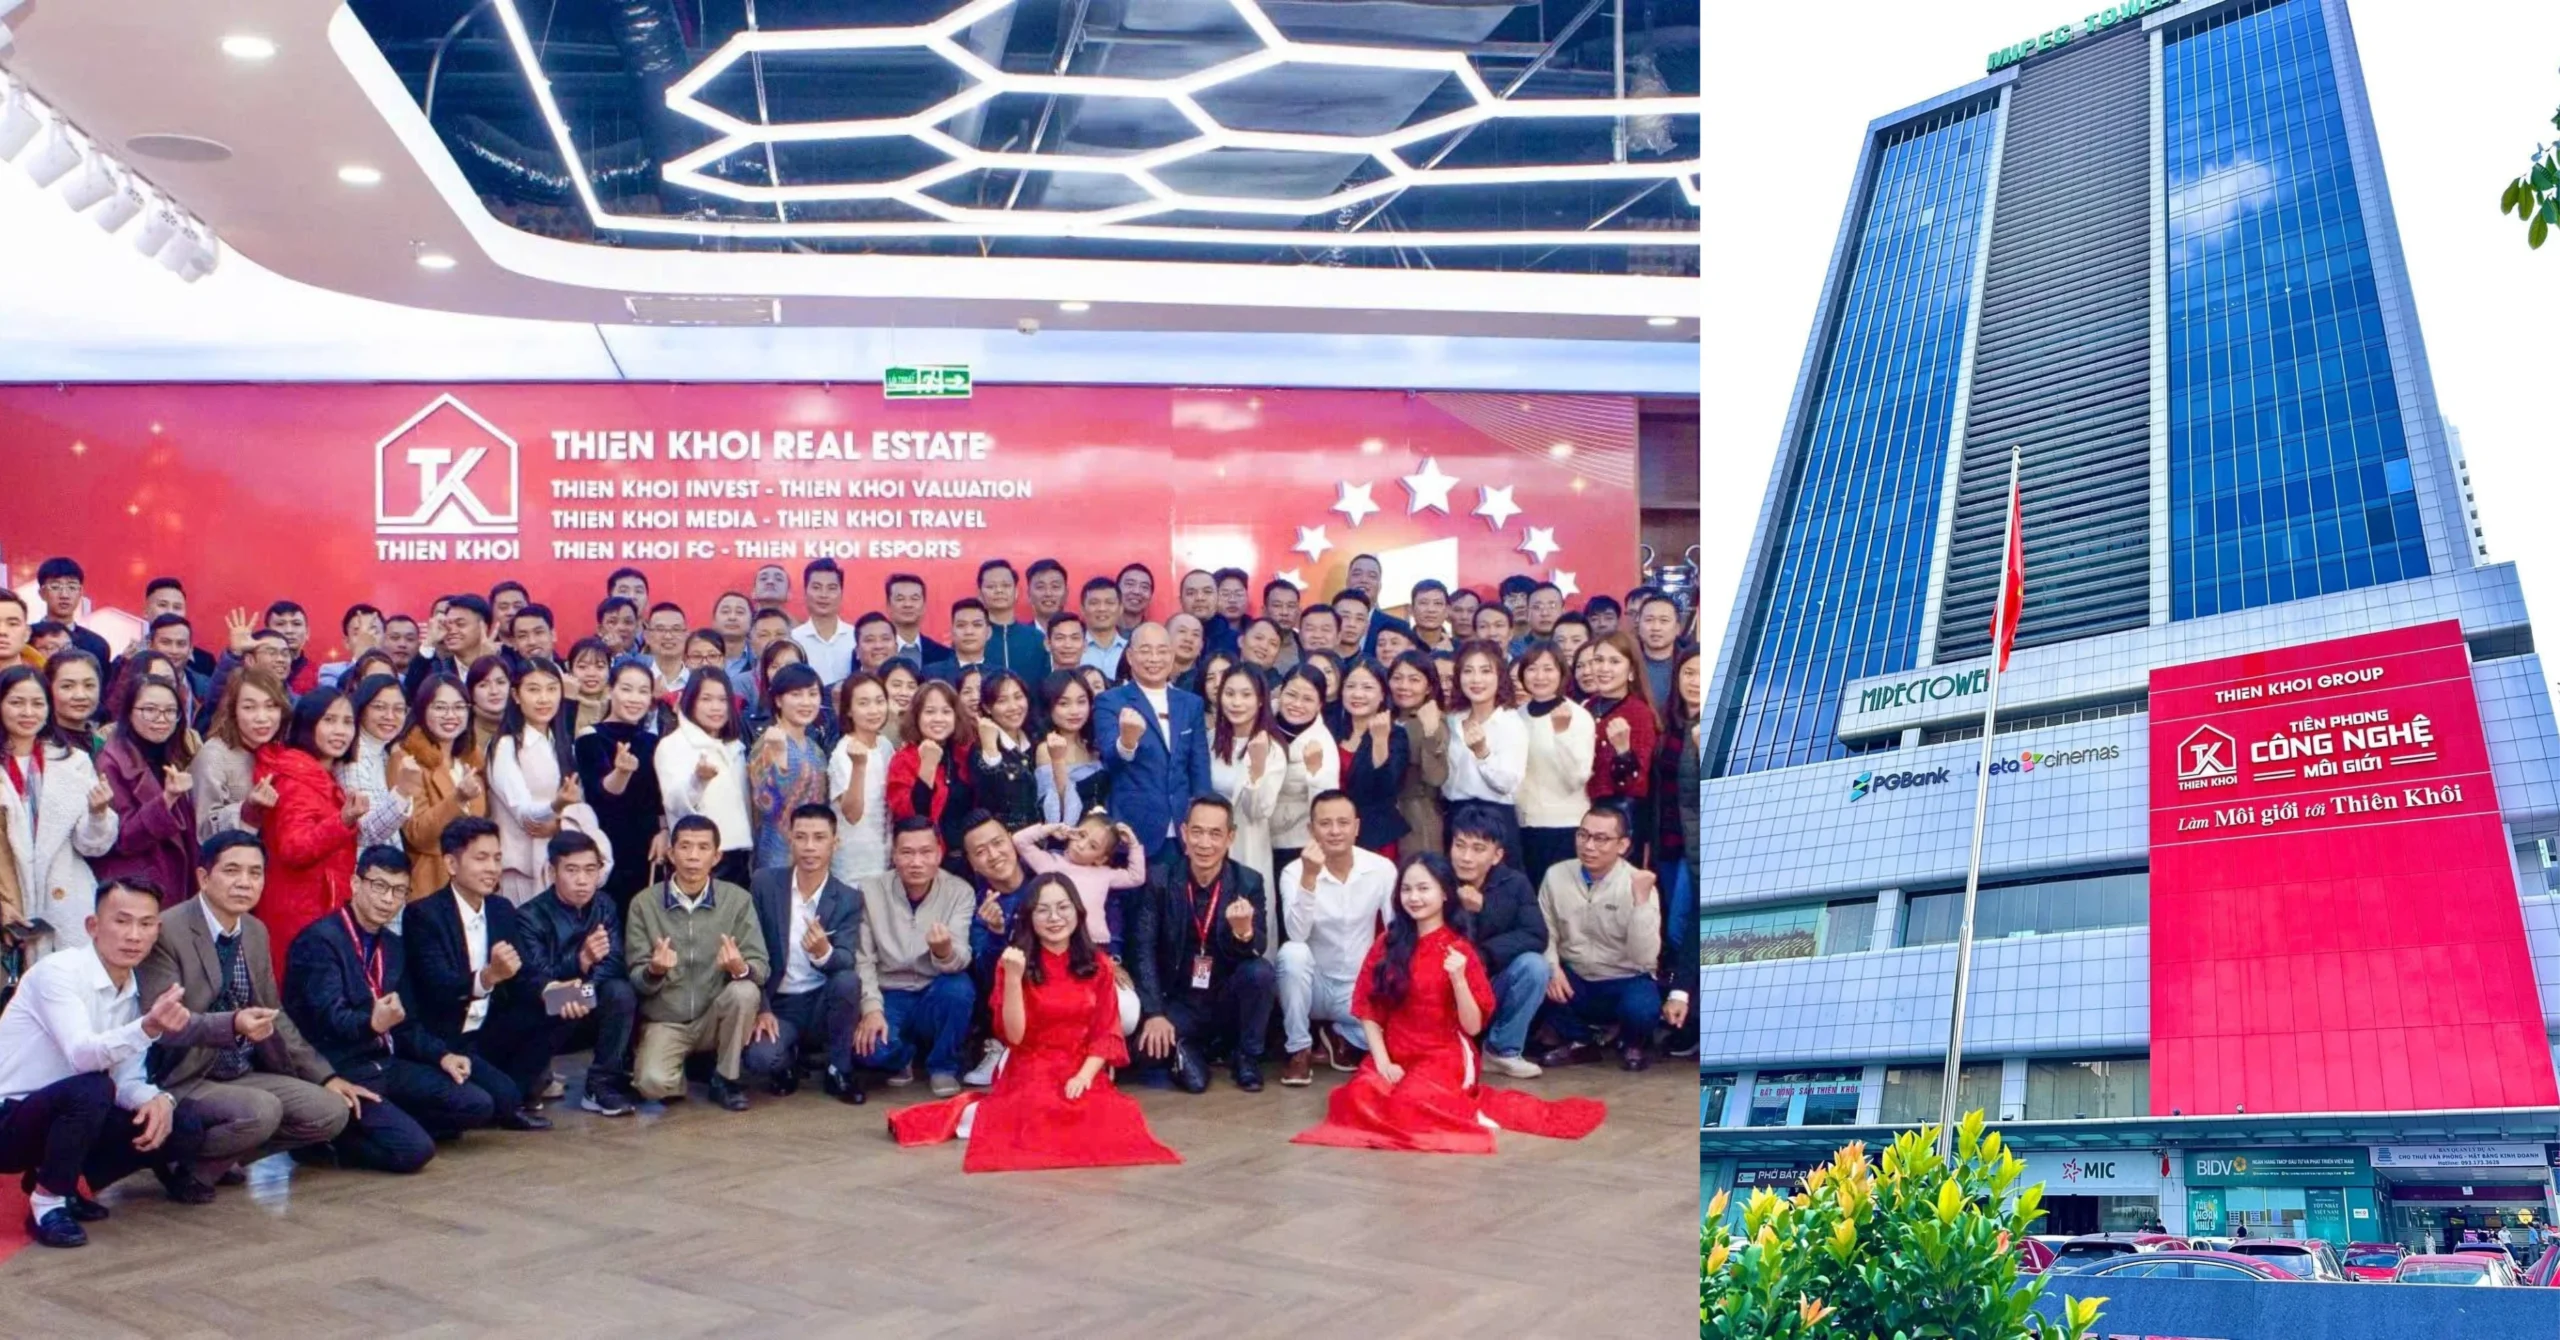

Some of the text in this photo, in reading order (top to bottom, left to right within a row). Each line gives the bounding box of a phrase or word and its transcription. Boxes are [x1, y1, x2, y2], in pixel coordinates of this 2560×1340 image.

[1986, 0, 2172, 71] MIPEC TOWE
[551, 430, 988, 460] THIEN KHOI REAL ESTATE
[551, 479, 614, 498] THIEN
[621, 479, 679, 498] KHOI
[686, 479, 760, 498] INVEST
[779, 479, 841, 498] THIEN
[848, 479, 904, 498] KHOI
[911, 479, 1032, 498] VALUATION
[551, 509, 614, 529] THIEN
[621, 510, 679, 529] KHOI
[686, 510, 757, 529] MEDIA
[777, 509, 838, 529] THIEN
[846, 509, 902, 528] KHOI
[909, 509, 987, 528] TRAVEL
[376, 539, 520, 561] THIEN KHOI
[551, 540, 614, 560] THIEN
[621, 540, 680, 560] KHOI
[686, 540, 715, 559] FC
[734, 540, 796, 559] THIEN
[804, 540, 860, 559] KHOI
[869, 540, 961, 559] ESPORTS
[2215, 667, 2384, 703] THIEN KHOI GROUP
[2289, 709, 2389, 733] TIÊN PHONG
[2251, 713, 2434, 763] CÔNG NGHỆ
[1976, 745, 2120, 776] eta cinemas
[2303, 753, 2382, 778] MÔI GIỚI
[1872, 766, 1950, 793] PGBank
[2178, 775, 2238, 791] THIEN KHOI
[2177, 784, 2463, 831] Làm Môi giới tới Thiên Khôi
[1779, 1167, 1799, 1179] BÁT
[2084, 1162, 2115, 1178] MIC
[2197, 1159, 2234, 1176] BIDV
